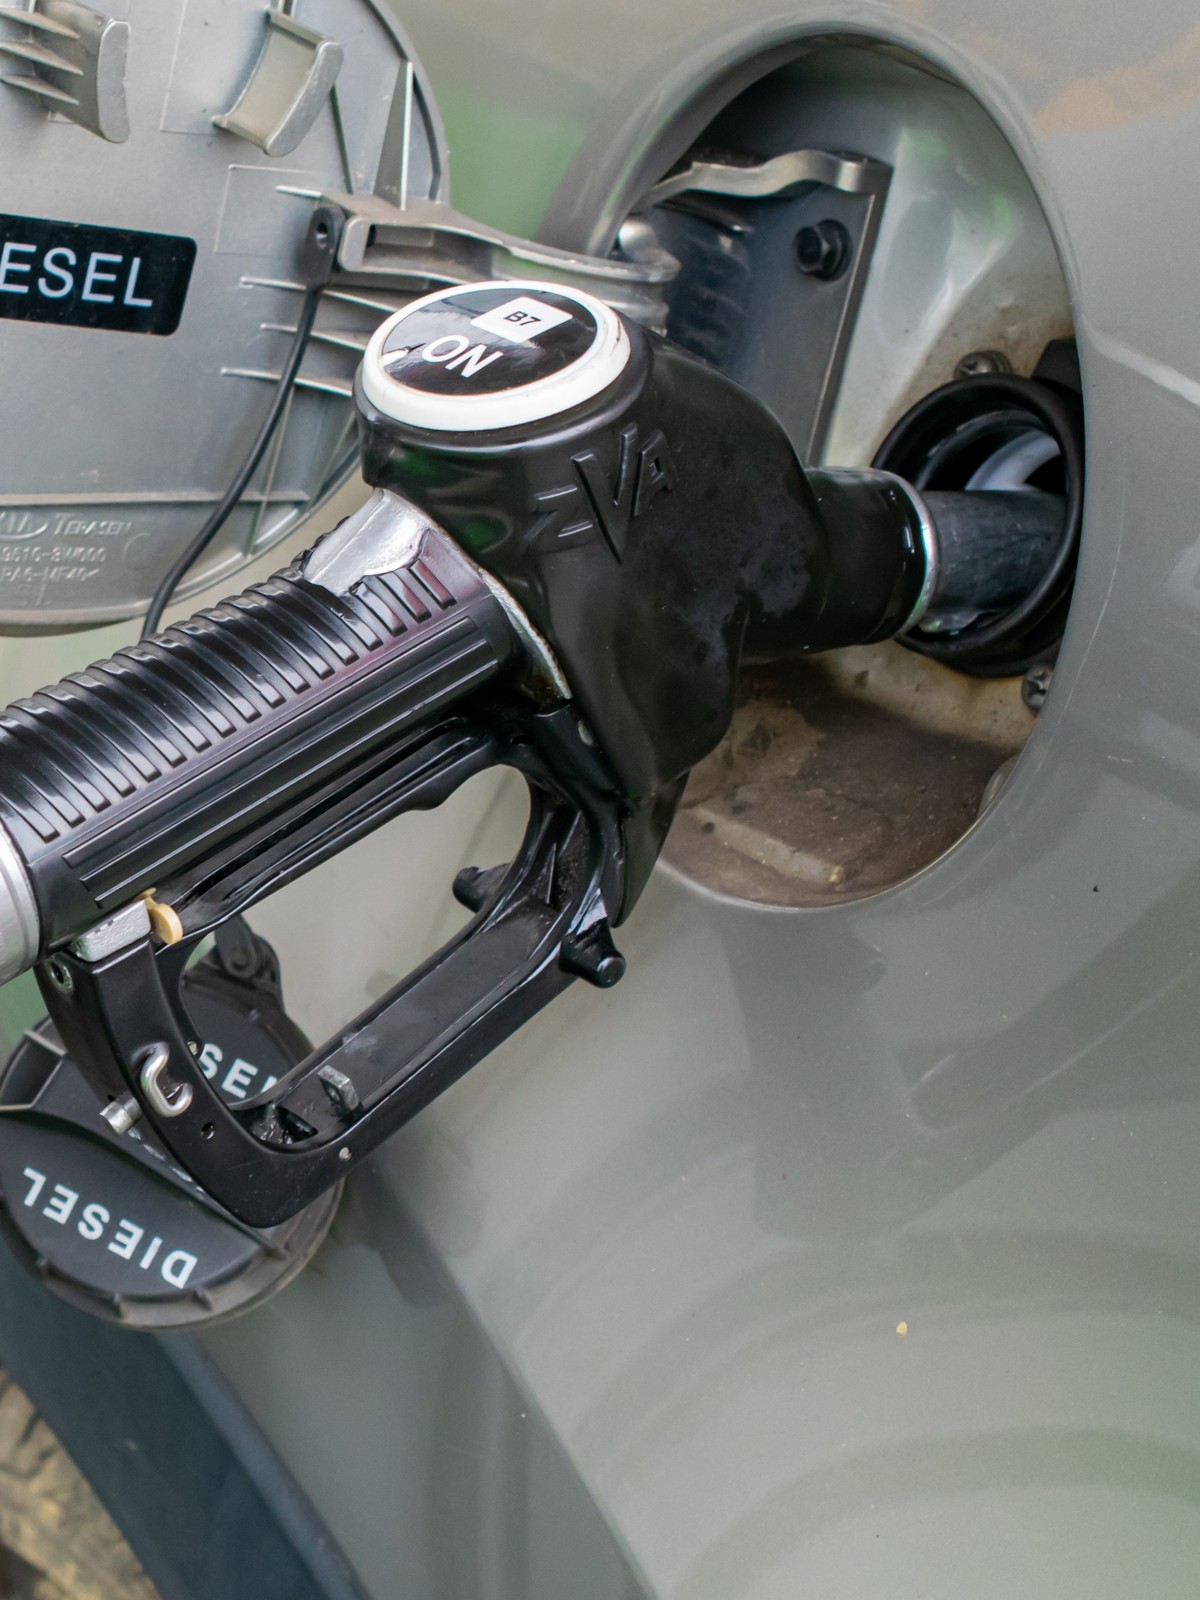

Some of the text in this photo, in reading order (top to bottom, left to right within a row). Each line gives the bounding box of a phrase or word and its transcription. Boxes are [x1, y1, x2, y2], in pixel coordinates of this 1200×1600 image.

[421, 334, 504, 378] ON
[503, 310, 542, 328] B7
[520, 421, 672, 564] ZVA
[23, 1167, 198, 1289] DIESEL
